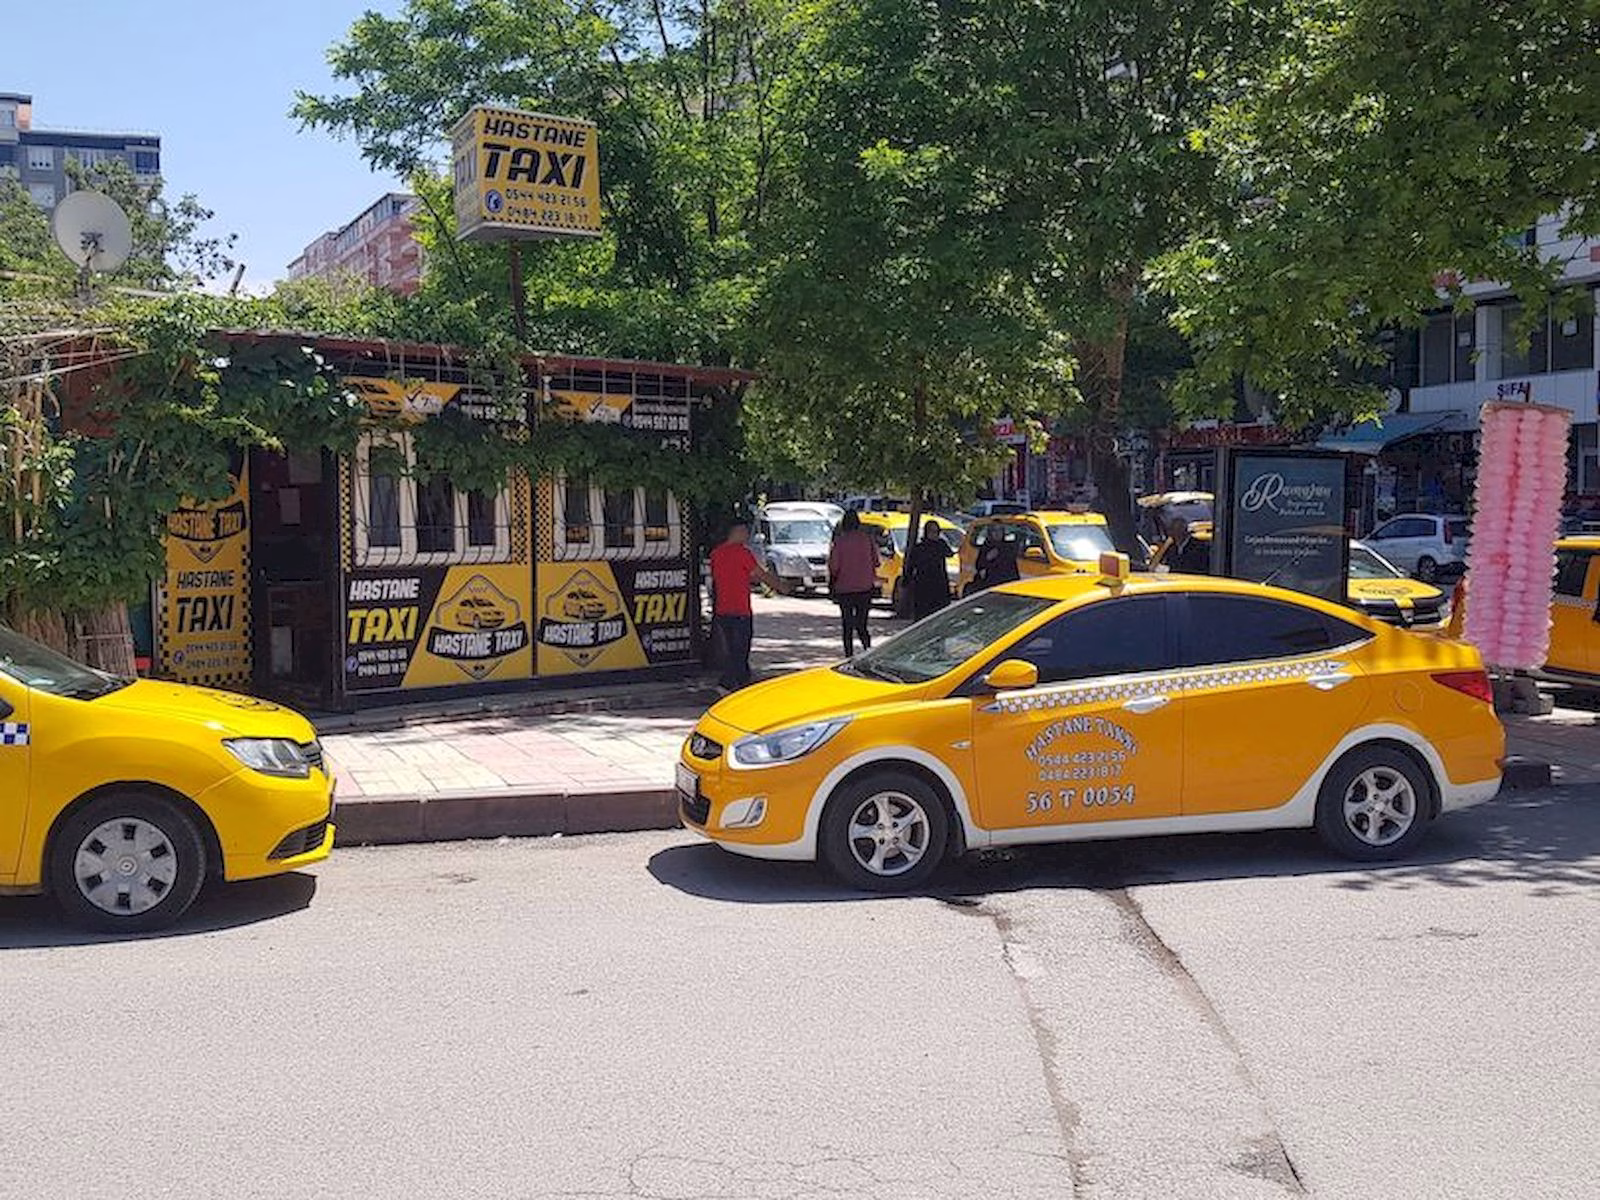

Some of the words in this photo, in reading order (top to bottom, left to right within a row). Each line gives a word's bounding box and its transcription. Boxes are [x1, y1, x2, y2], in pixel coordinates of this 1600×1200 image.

[483, 118, 587, 148] HASTANE
[482, 142, 587, 189] TAXI
[177, 570, 235, 589] HASTANE
[349, 578, 420, 601] HASTANE
[634, 569, 688, 589] HASTANE
[177, 595, 235, 633] TAXI
[634, 592, 687, 624] TAXI
[348, 606, 419, 644] TAXI
[543, 623, 595, 645] HASTANE
[598, 620, 624, 642] TAXI
[434, 633, 492, 656] HASTANE
[495, 630, 523, 651] TAXI
[1025, 716, 1093, 760] HASTANE
[1026, 791, 1053, 814] 56
[1059, 788, 1076, 808] T
[1083, 784, 1136, 807] 0054
